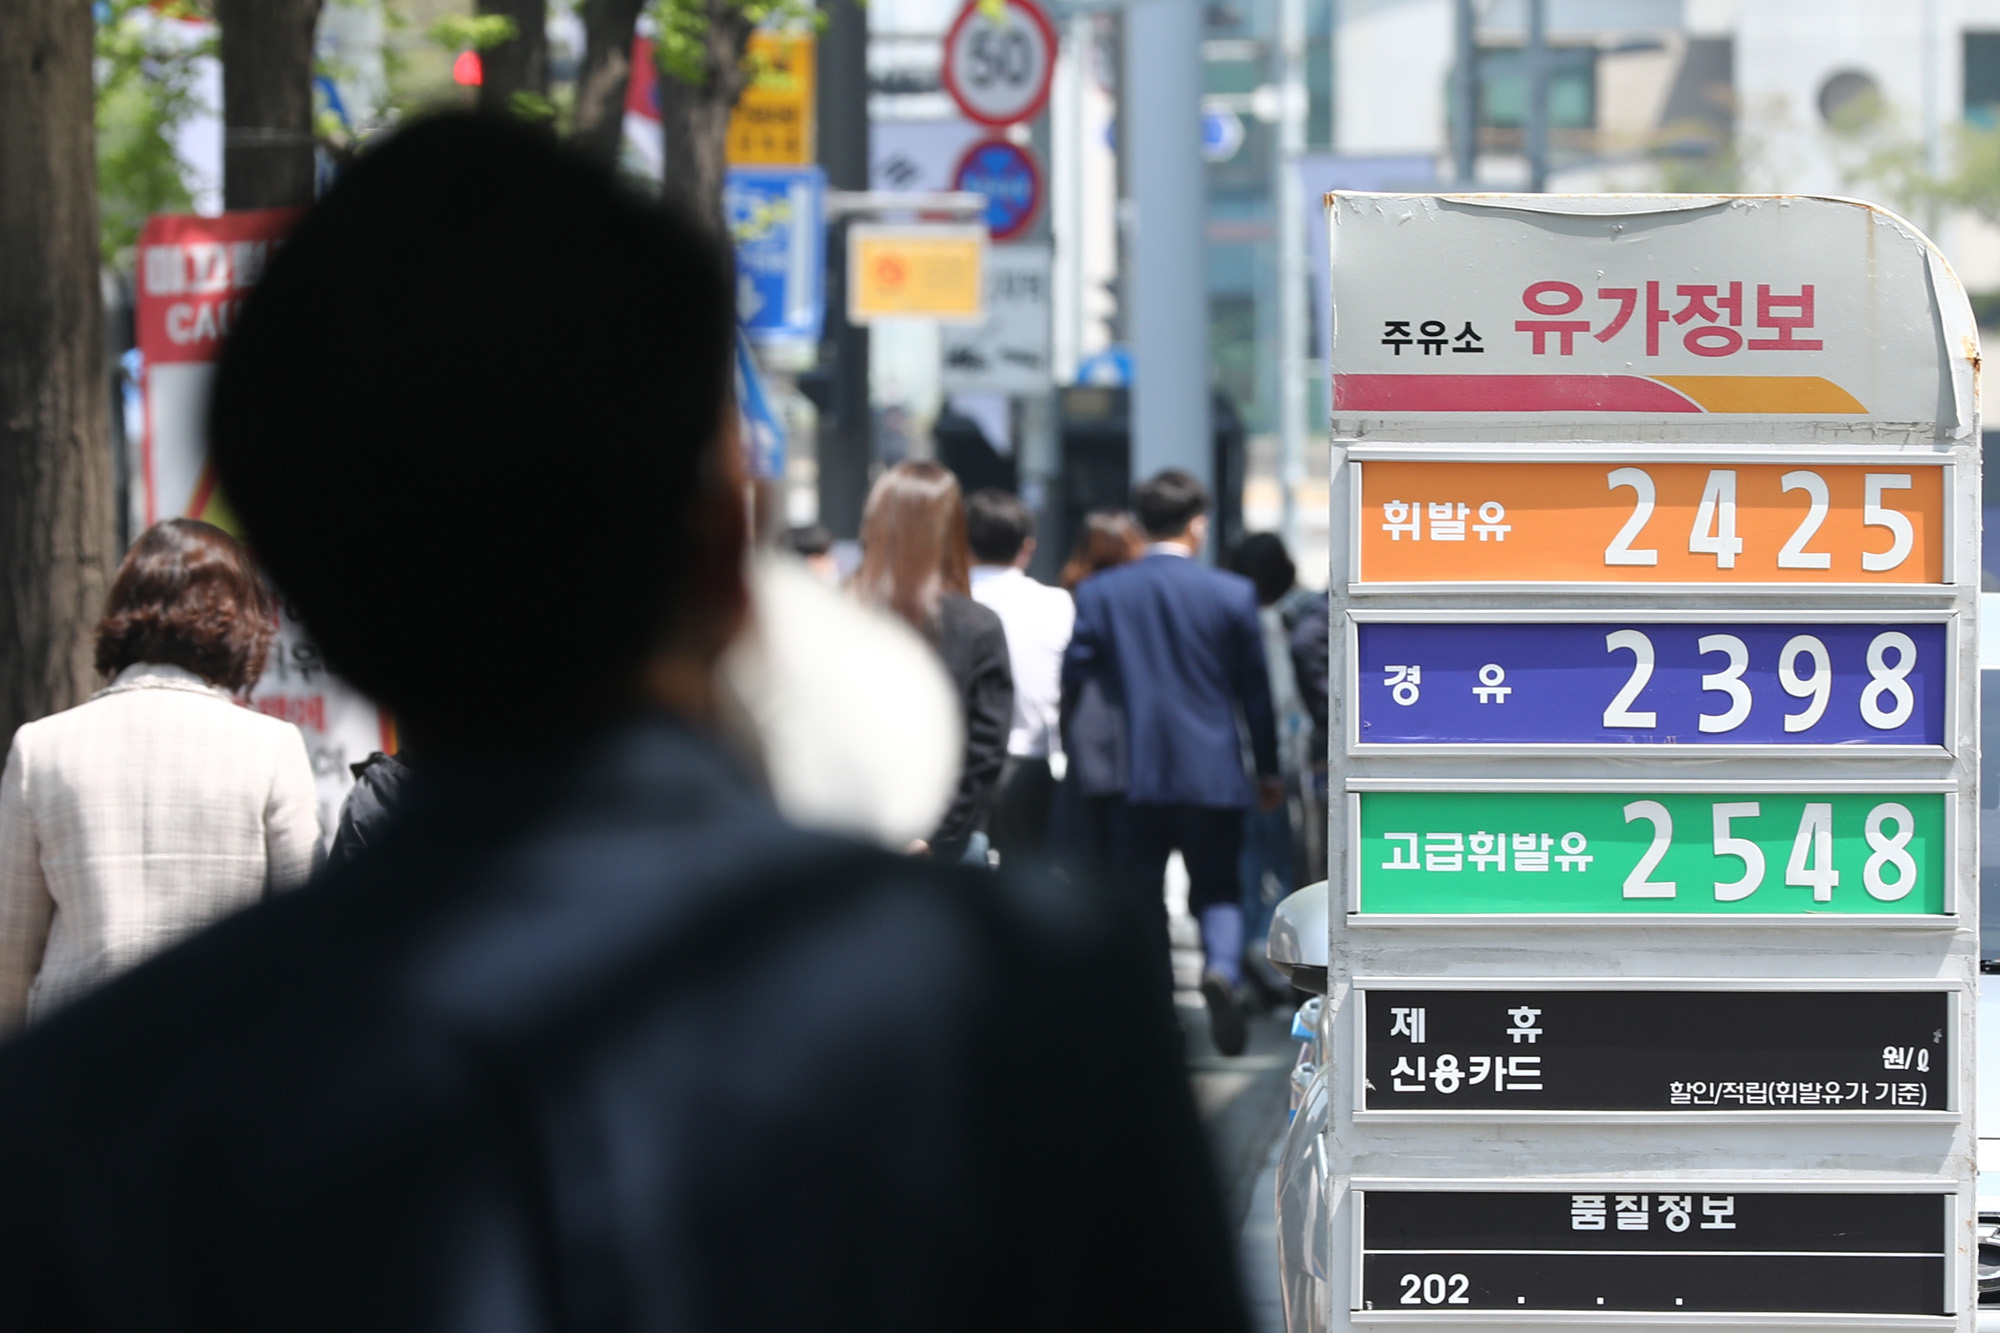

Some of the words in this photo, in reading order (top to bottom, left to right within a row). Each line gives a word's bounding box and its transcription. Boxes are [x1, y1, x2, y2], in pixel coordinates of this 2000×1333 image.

[967, 28, 1033, 89] 50
[1381, 320, 1484, 356] 주유소
[1514, 281, 1824, 357] 유가정보
[1381, 499, 1513, 542] 휘발유
[1604, 467, 1915, 572] 2425
[1602, 629, 1918, 733] 2398
[1381, 830, 1594, 872] 고급휘발유
[1622, 800, 1918, 902] 2548
[1390, 1054, 1543, 1094] 신용카드
[1875, 1082, 1928, 1107] 기준)
[1570, 1194, 1737, 1233] 품질정보
[1399, 1273, 1470, 1305] 202
